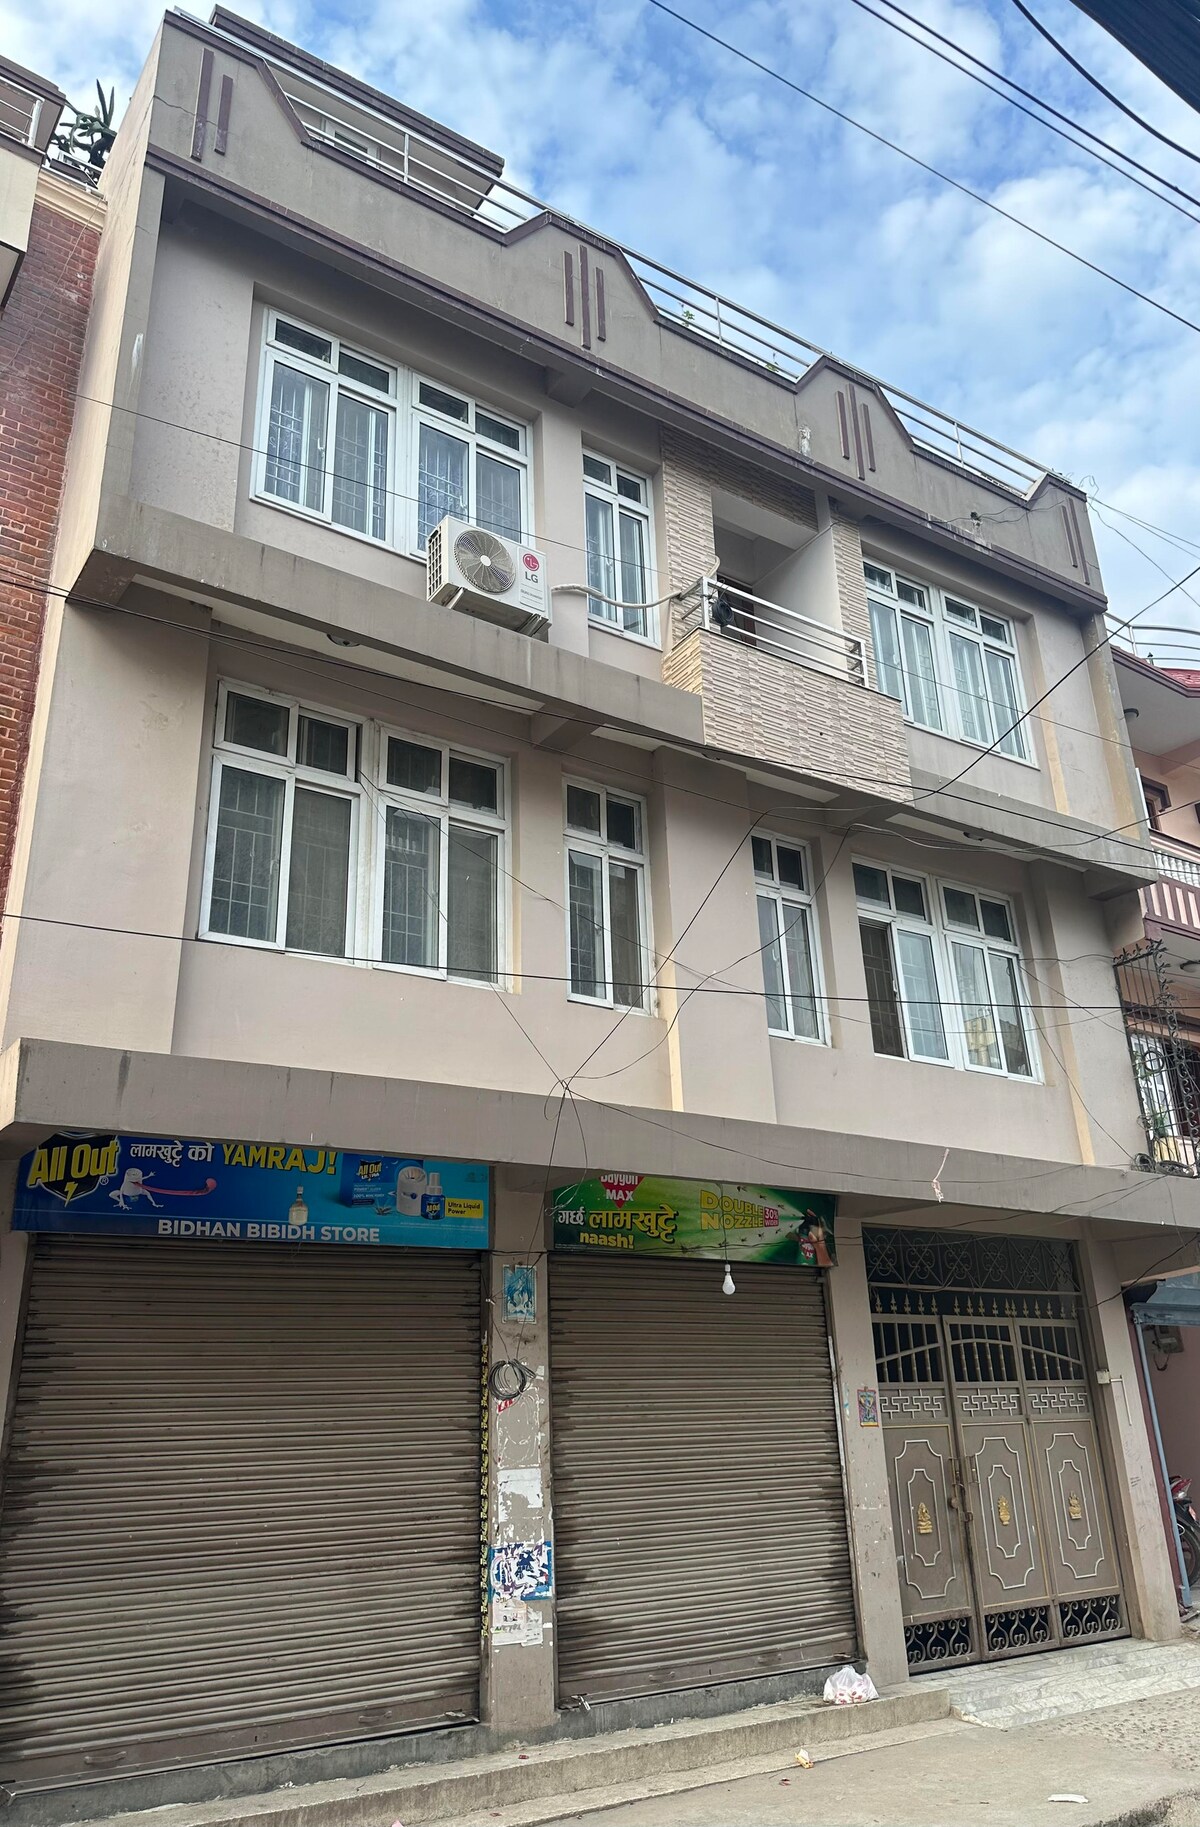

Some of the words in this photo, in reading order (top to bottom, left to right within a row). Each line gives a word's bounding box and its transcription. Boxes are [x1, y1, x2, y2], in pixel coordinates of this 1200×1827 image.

[525, 571, 538, 583] LG
[27, 1147, 67, 1187] All
[70, 1138, 118, 1178] Out
[130, 1140, 184, 1167] लामखुट्टे
[188, 1142, 215, 1161] को
[222, 1143, 337, 1175] YAMRAJ!
[357, 1164, 368, 1176] All
[369, 1162, 381, 1173] Out
[606, 1189, 634, 1202] MAX
[700, 1189, 763, 1216] DOUBLE
[588, 1204, 678, 1243] लामखुट्टे
[700, 1210, 763, 1231] NOZZLE
[764, 1207, 778, 1220] 30%
[158, 1219, 240, 1237] BIDHAN
[247, 1223, 315, 1240] BIBIDH
[320, 1225, 380, 1242] STORE
[579, 1232, 634, 1249] naash!
